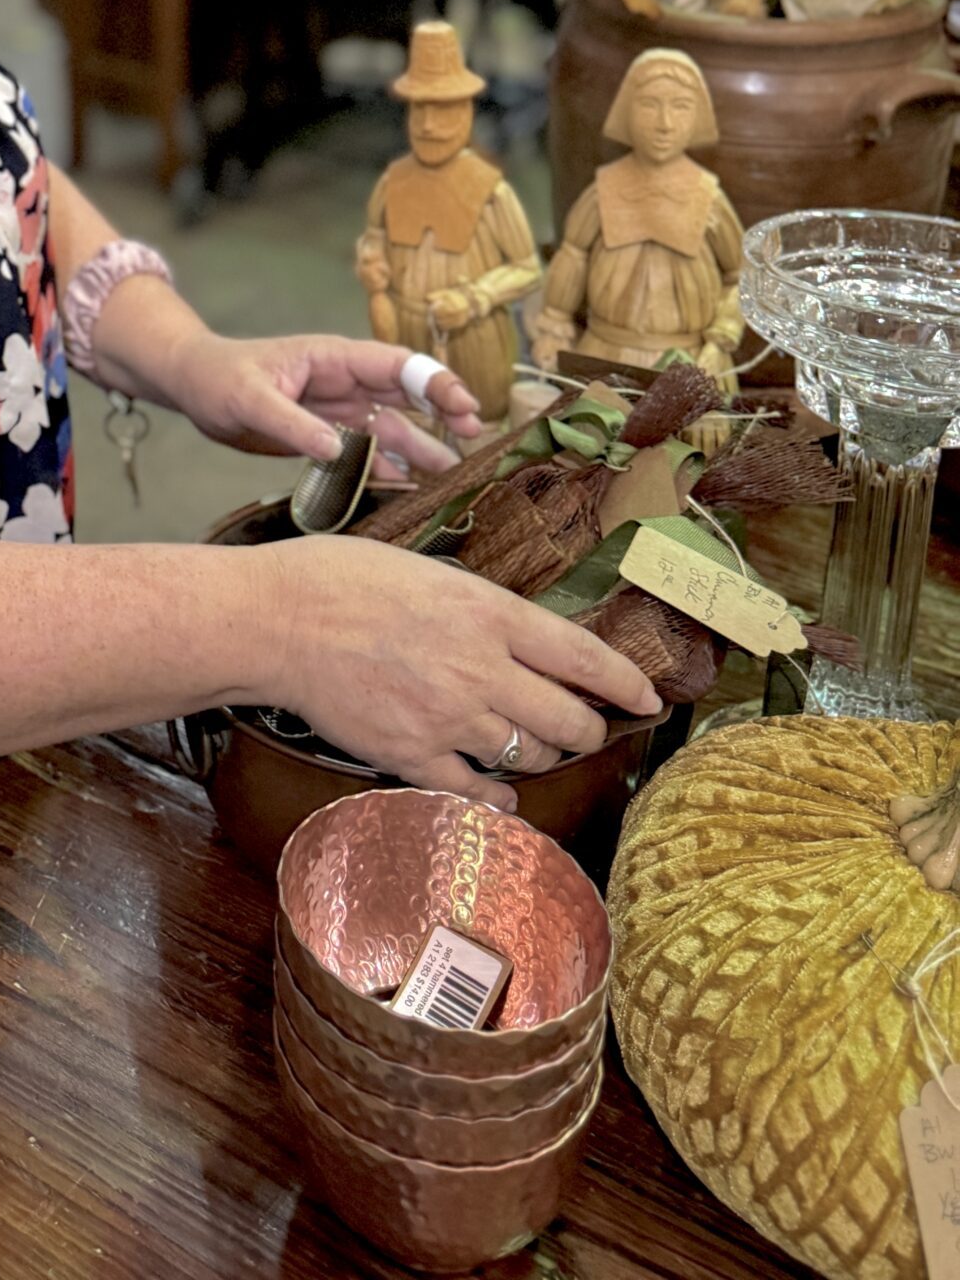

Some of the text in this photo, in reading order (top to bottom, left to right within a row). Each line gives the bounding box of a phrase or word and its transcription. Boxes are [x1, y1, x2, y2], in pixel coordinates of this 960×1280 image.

[404, 939, 443, 1008] A1 2183 $14.00
[442, 946, 453, 962] set
[414, 970, 445, 1016] hammered
